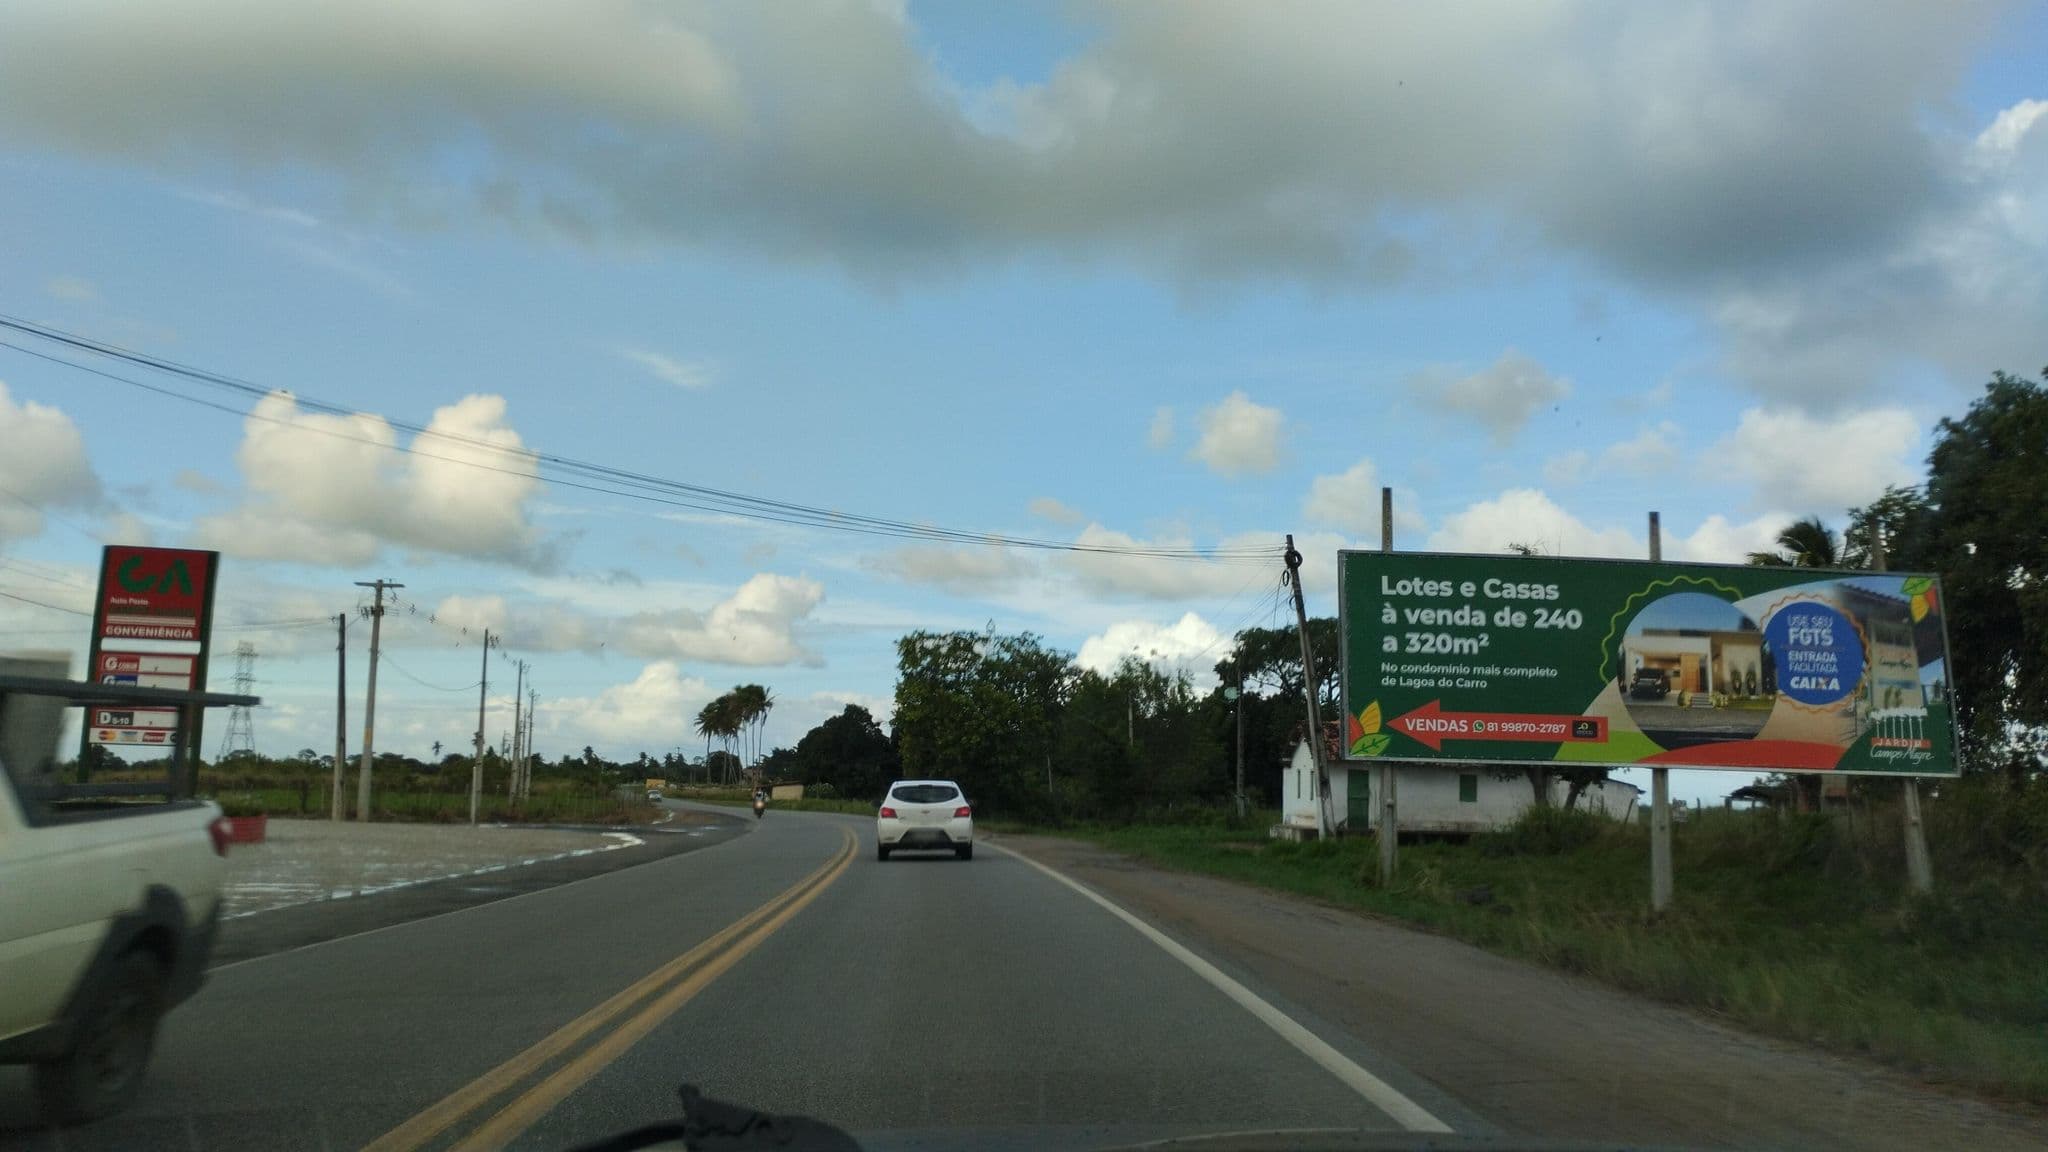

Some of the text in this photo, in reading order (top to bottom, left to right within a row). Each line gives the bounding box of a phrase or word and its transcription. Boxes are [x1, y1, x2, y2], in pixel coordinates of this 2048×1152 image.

[1381, 575, 1560, 600] Lotes e Casas
[1381, 602, 1583, 629] à venda de 240
[1382, 634, 1398, 652] a
[1789, 628, 1834, 646] FGTS
[1788, 650, 1837, 663] ENTRADA
[1381, 662, 1398, 673] No
[1472, 664, 1500, 676] mais
[1503, 667, 1558, 679] completo
[1381, 676, 1488, 688] de Lagoa do Carro
[1790, 676, 1840, 690] CAIXA
[100, 712, 111, 724] D
[1405, 718, 1468, 733] VENDAS
[1487, 722, 1566, 734] 81 99870-2787
[1879, 739, 1922, 748] JARDIM
[1870, 744, 1902, 764] Campo
